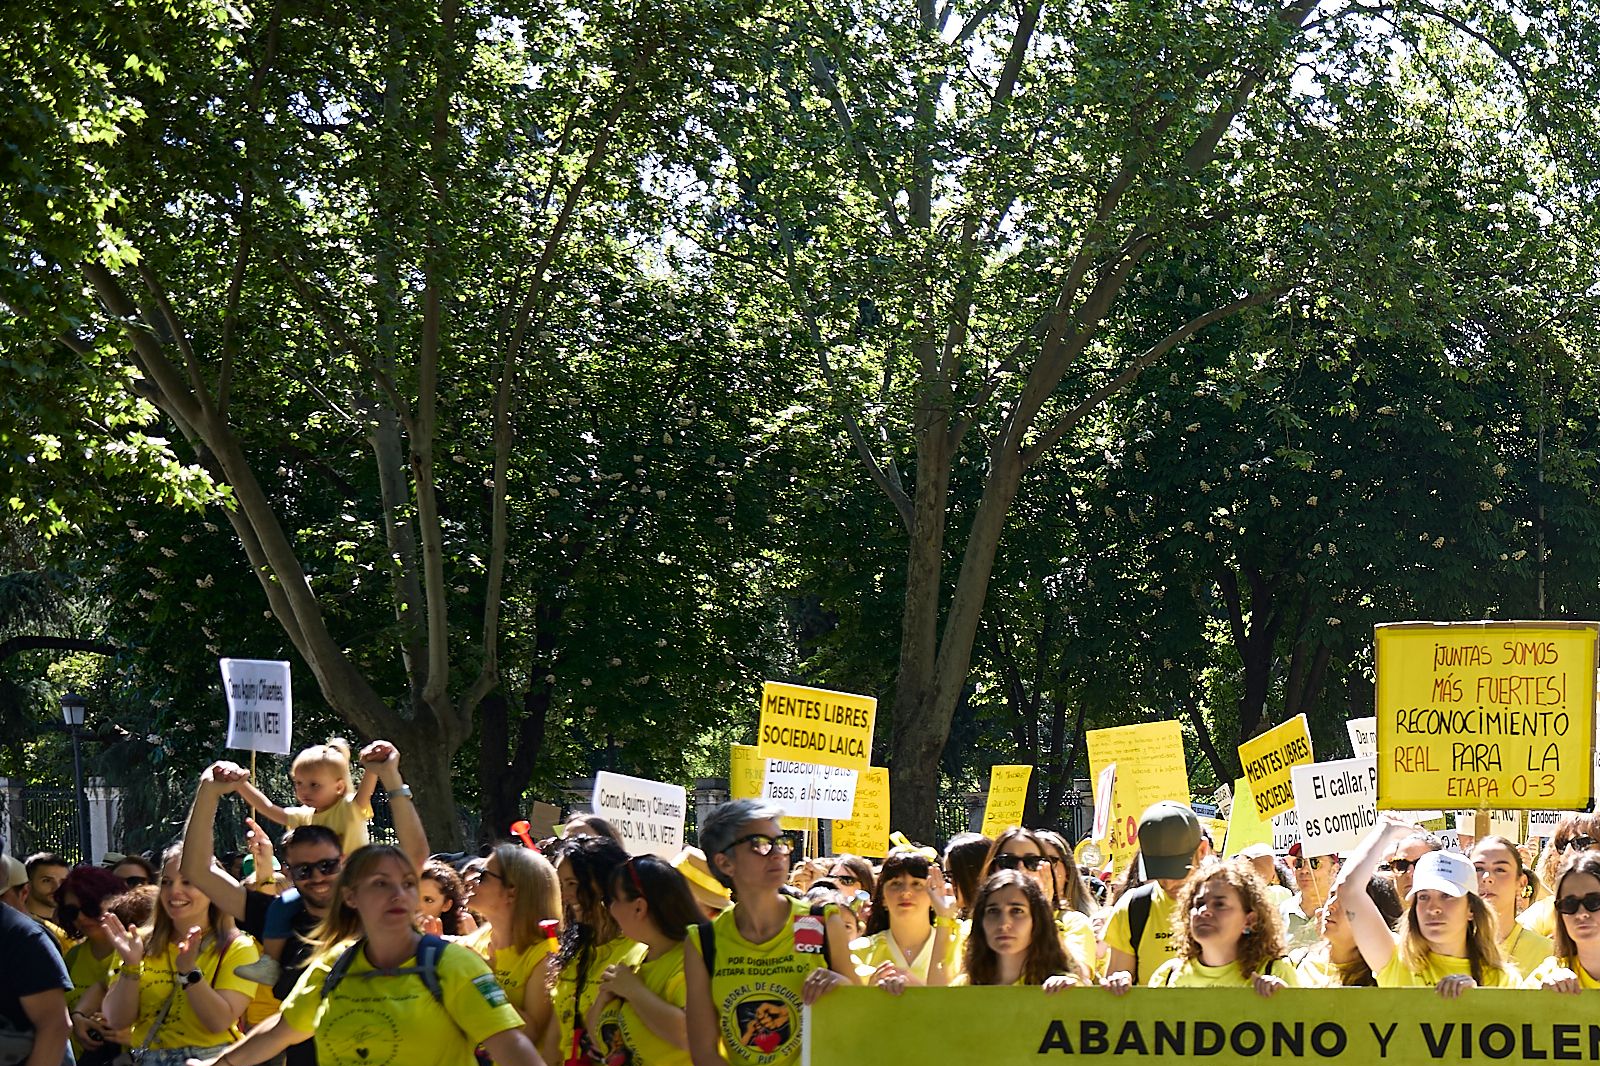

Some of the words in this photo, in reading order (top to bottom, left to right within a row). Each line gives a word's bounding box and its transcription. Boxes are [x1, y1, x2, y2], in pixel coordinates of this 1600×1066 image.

[1433, 643, 1492, 672] ¡JUNTAS
[1502, 641, 1558, 666] SOMOS
[1432, 672, 1463, 703] MÁS
[1476, 673, 1567, 709] FUERTES!
[767, 694, 820, 721] MENTES
[824, 703, 870, 733] LIBRES,
[763, 725, 826, 751] SOCIEDAD
[829, 734, 867, 759] LAICA.
[1356, 729, 1369, 745] Dar
[1245, 752, 1283, 784] MENTES
[1395, 745, 1440, 773] REAL
[1452, 742, 1502, 773] PARA
[1527, 743, 1560, 772] LA
[768, 781, 798, 803] Tasas,
[800, 788, 807, 801] a
[824, 785, 850, 802] ricos.
[1312, 775, 1327, 800] El
[1330, 771, 1369, 797] callar,
[1447, 776, 1499, 798] ETAPA
[1512, 774, 1556, 797] 0-3
[601, 789, 620, 809] Como
[1305, 815, 1321, 838] es
[795, 942, 823, 954] CGT
[728, 956, 745, 966] POR
[747, 954, 795, 968] DIGNIFICAR
[748, 965, 795, 977] EDUCATIVA
[755, 981, 767, 991] DE
[1038, 1020, 1348, 1059] ABANDONO
[1369, 1022, 1398, 1058] Y
